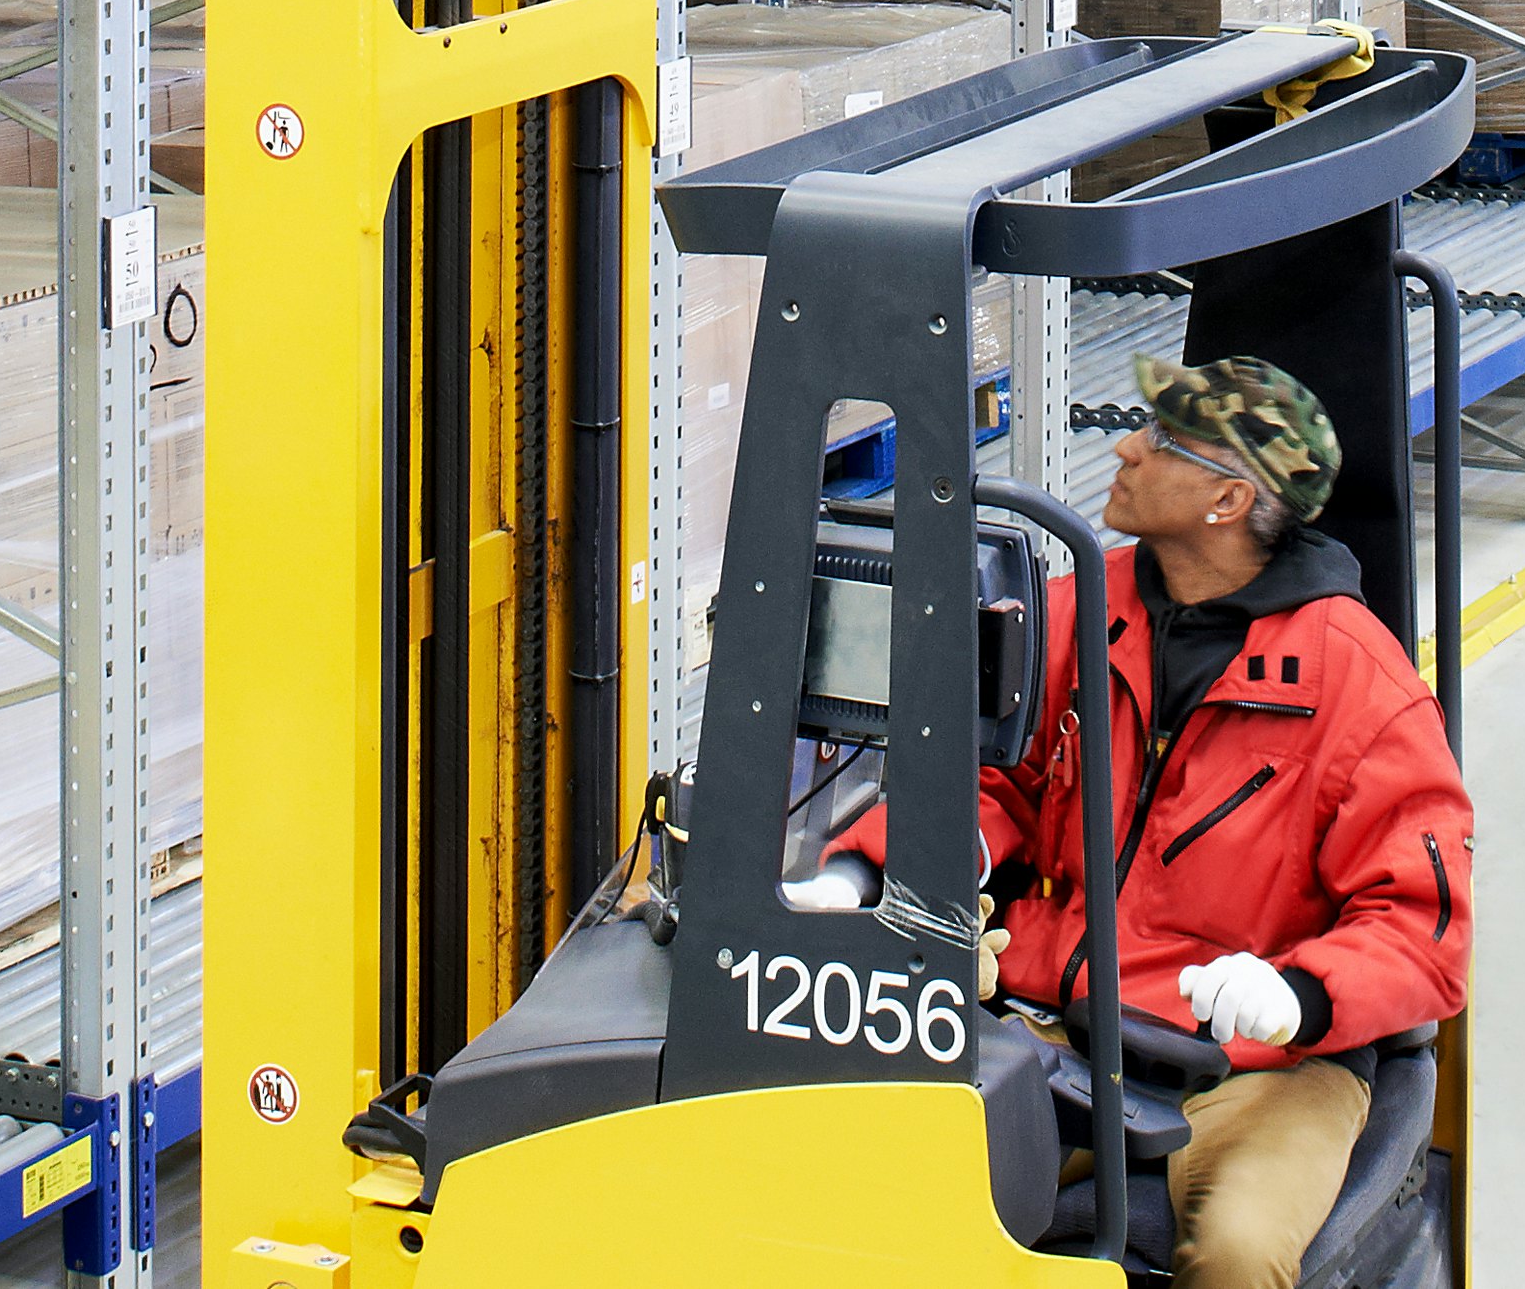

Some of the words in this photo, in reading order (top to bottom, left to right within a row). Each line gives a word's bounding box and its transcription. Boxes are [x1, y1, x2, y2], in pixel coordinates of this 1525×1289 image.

[670, 102, 679, 116] 49
[126, 261, 139, 280] 50
[731, 950, 966, 1064] 12056
